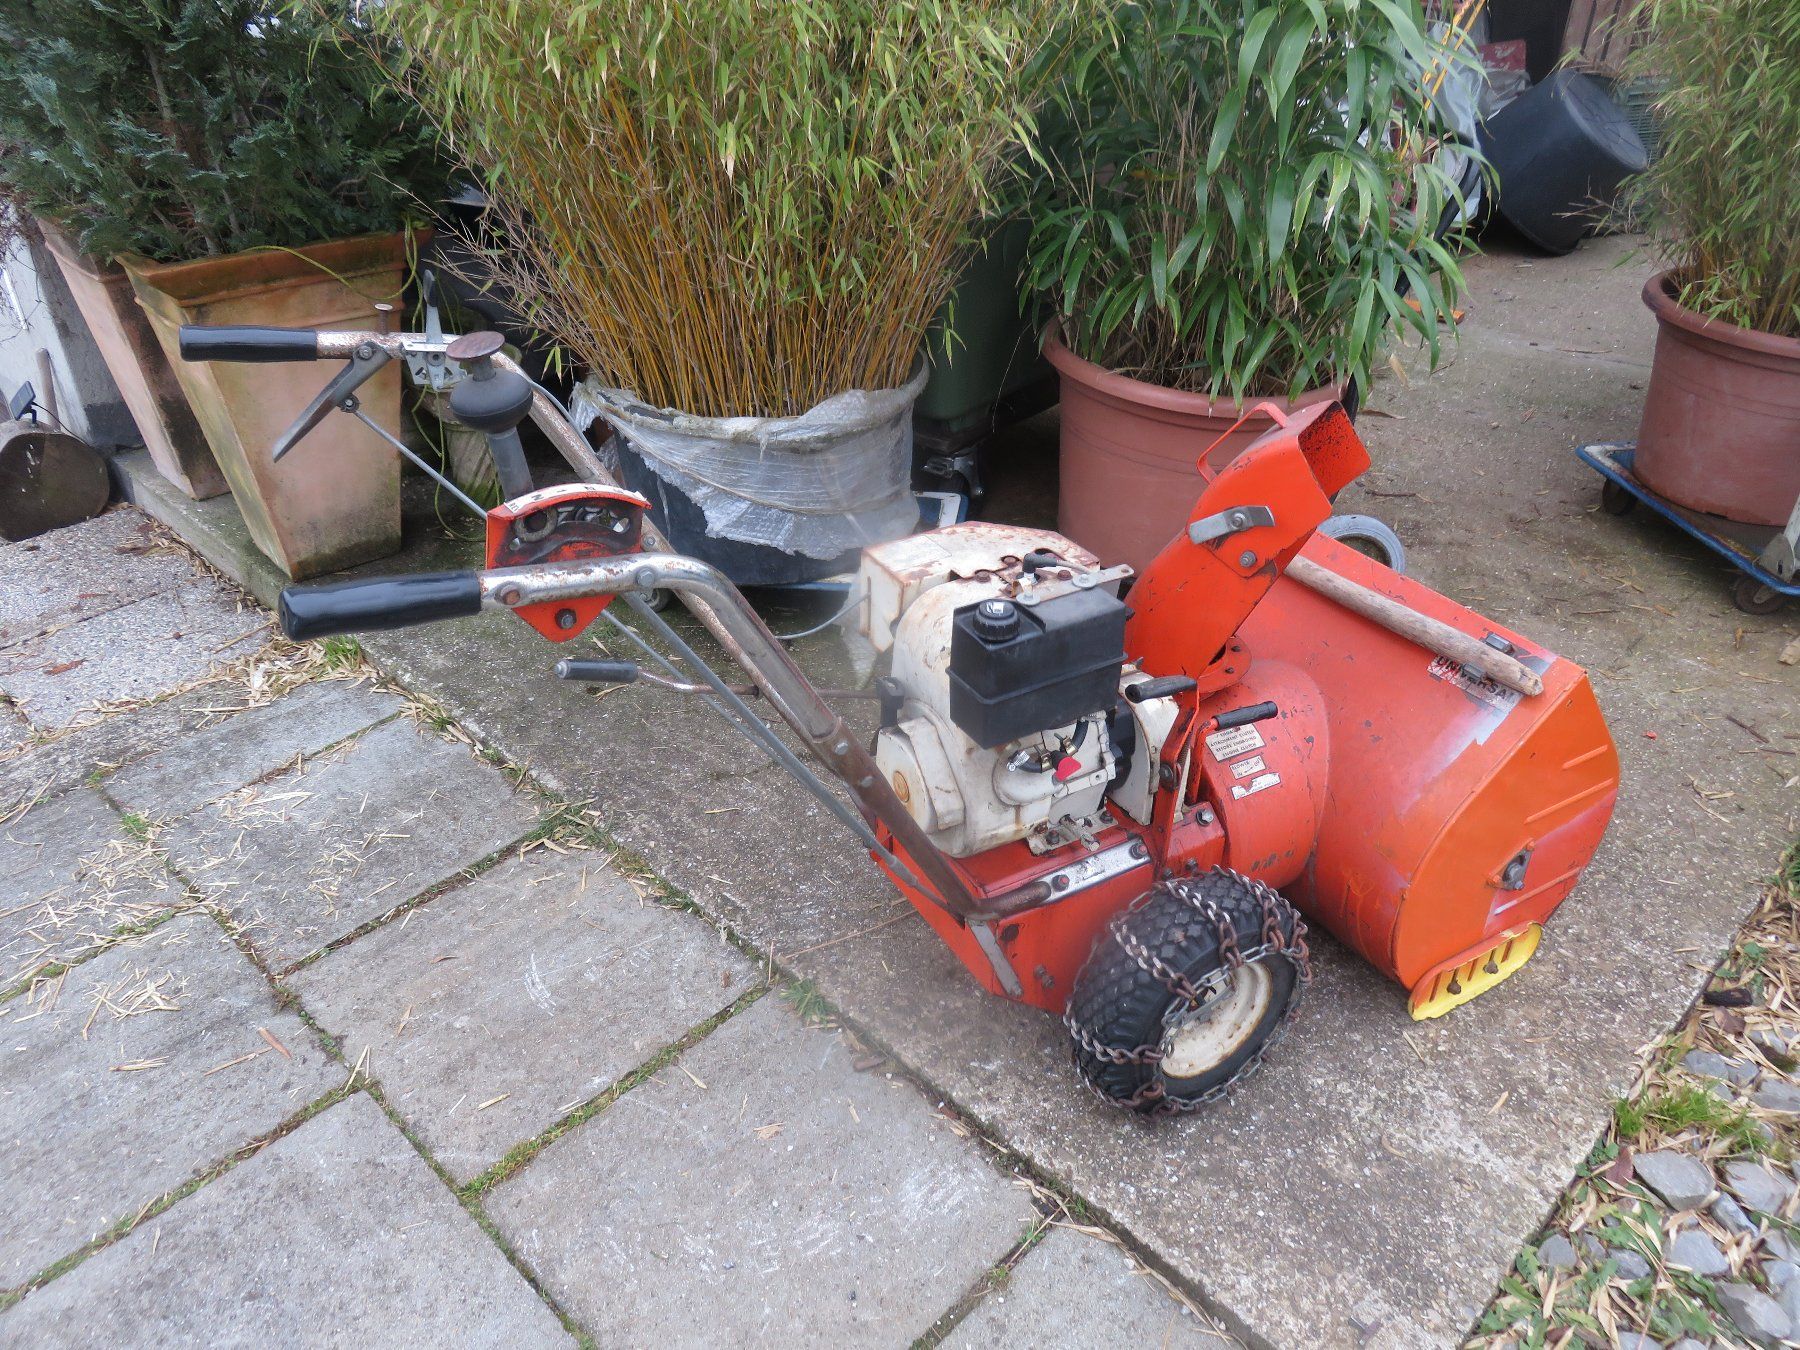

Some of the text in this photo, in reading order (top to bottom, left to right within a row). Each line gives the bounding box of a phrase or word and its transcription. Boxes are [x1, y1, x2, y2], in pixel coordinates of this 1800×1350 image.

[1210, 735, 1238, 748] ATTACHMENT
[1216, 735, 1257, 753] BEFORE ENGAGING
[1222, 743, 1257, 758] ENGINE CLUTCH
[1231, 757, 1262, 771] BLOWER OUT
